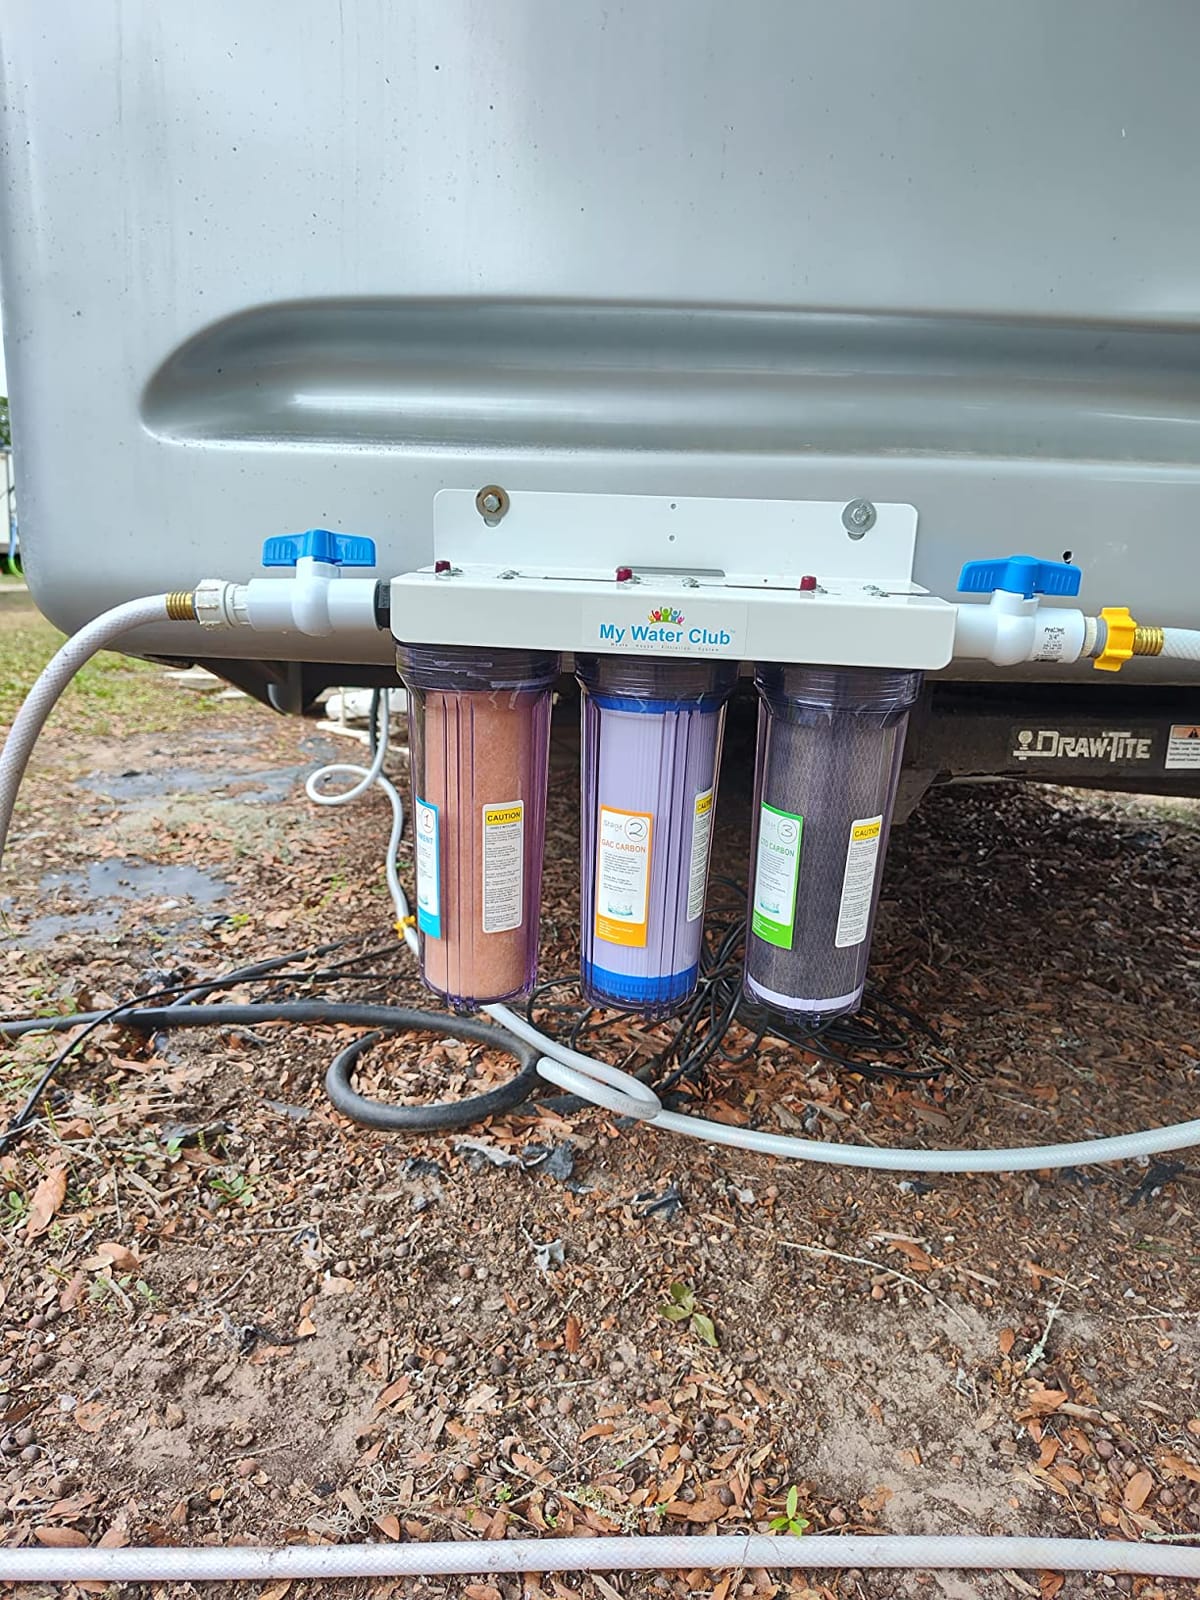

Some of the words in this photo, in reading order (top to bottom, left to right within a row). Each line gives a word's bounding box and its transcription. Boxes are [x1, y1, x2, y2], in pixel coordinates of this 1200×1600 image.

[599, 624, 625, 643] My
[631, 625, 683, 643] Water
[688, 628, 731, 645] Club
[424, 814, 431, 829] 1
[487, 811, 521, 823] CAUTION
[628, 822, 643, 838] 2
[781, 824, 793, 838] 3
[601, 839, 615, 849] GAC
[615, 842, 646, 854] CARBON
[769, 840, 795, 857] CARBON
